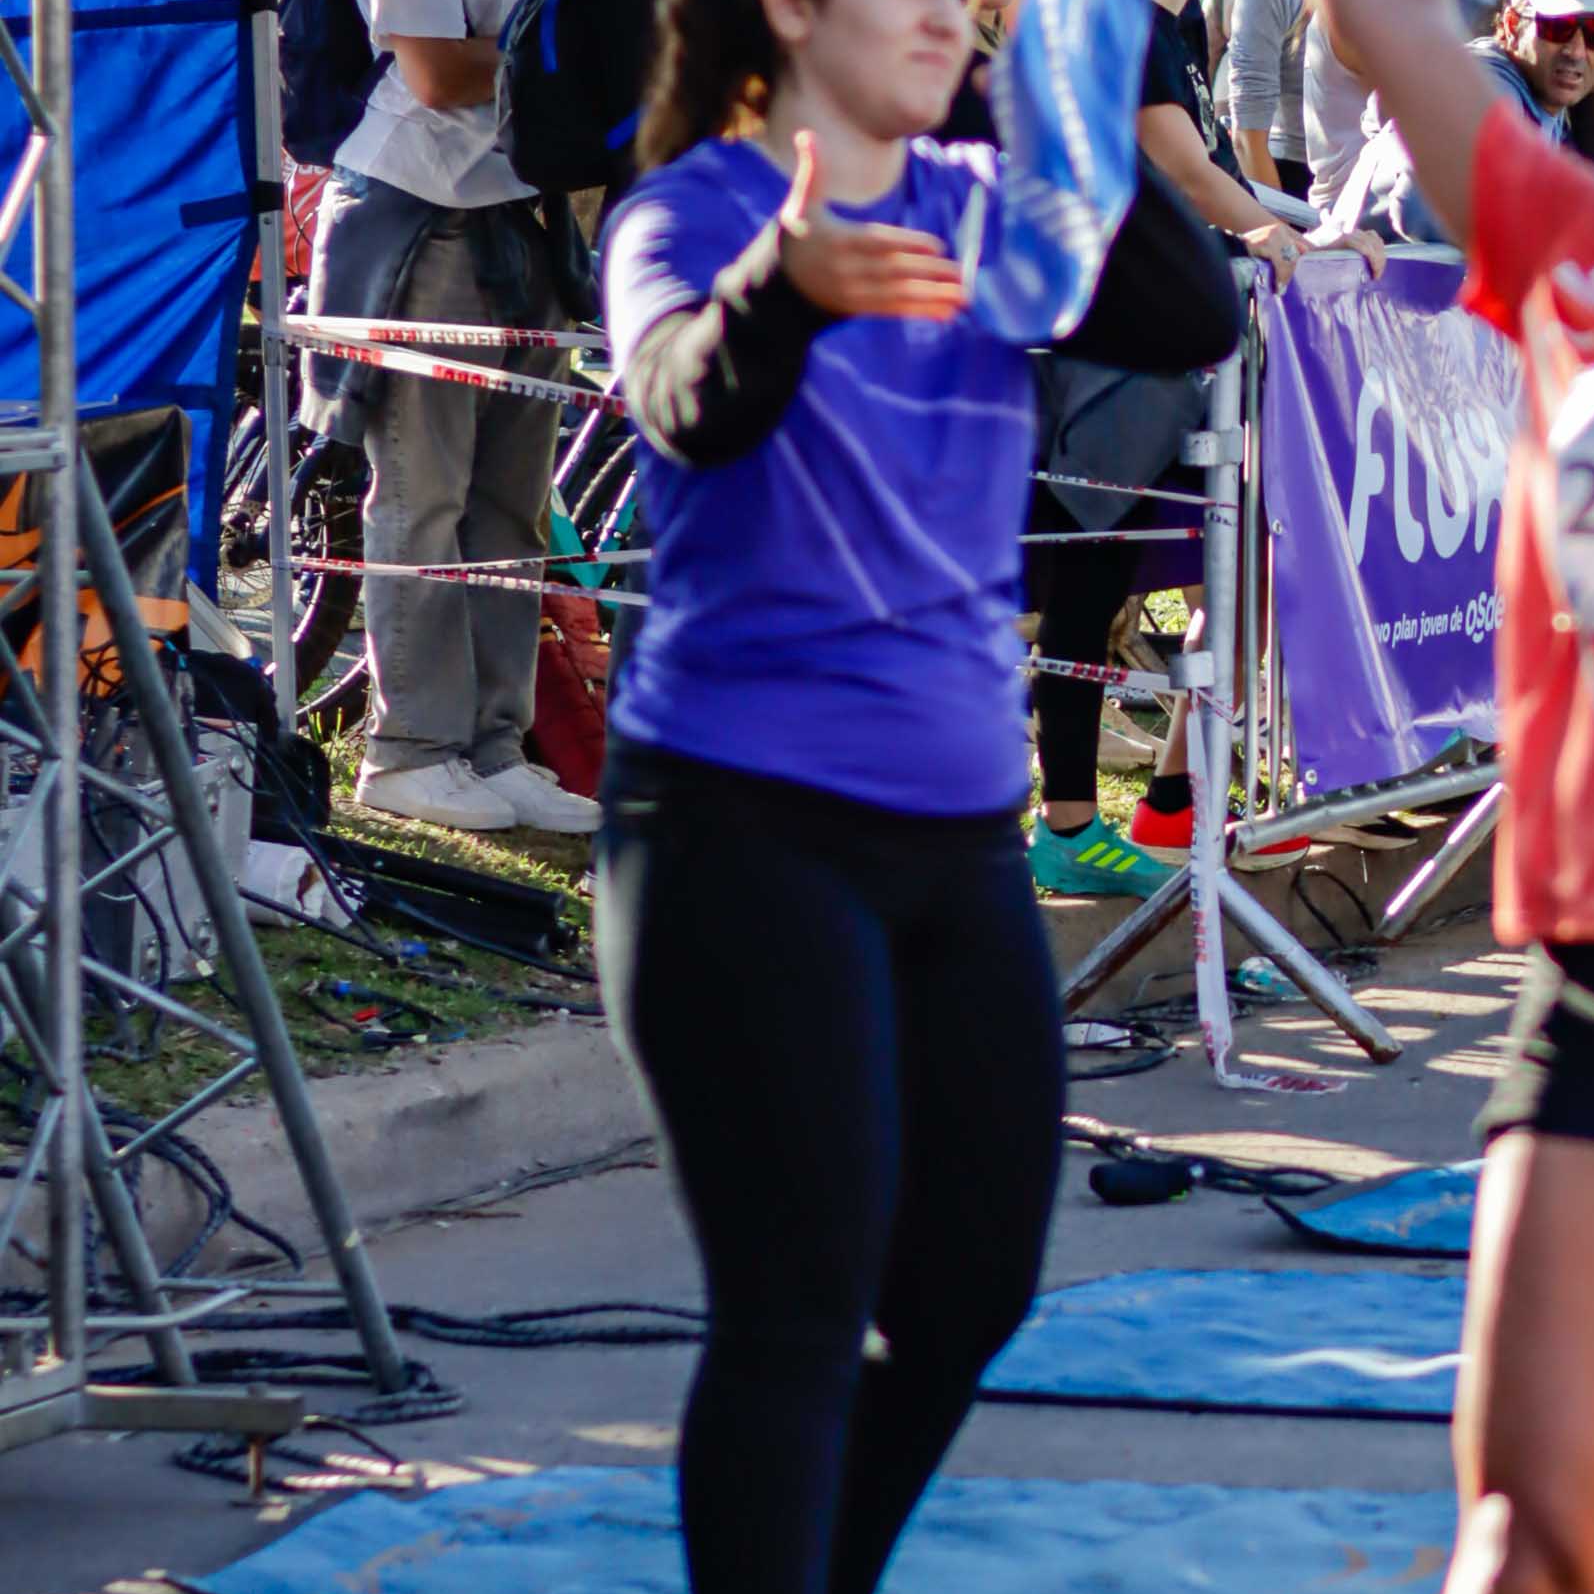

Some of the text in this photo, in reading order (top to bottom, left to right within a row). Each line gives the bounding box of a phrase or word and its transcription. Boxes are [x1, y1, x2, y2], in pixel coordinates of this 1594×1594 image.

[1391, 612, 1418, 649] plan
[1417, 609, 1448, 646] joven
[1450, 604, 1463, 632] de
